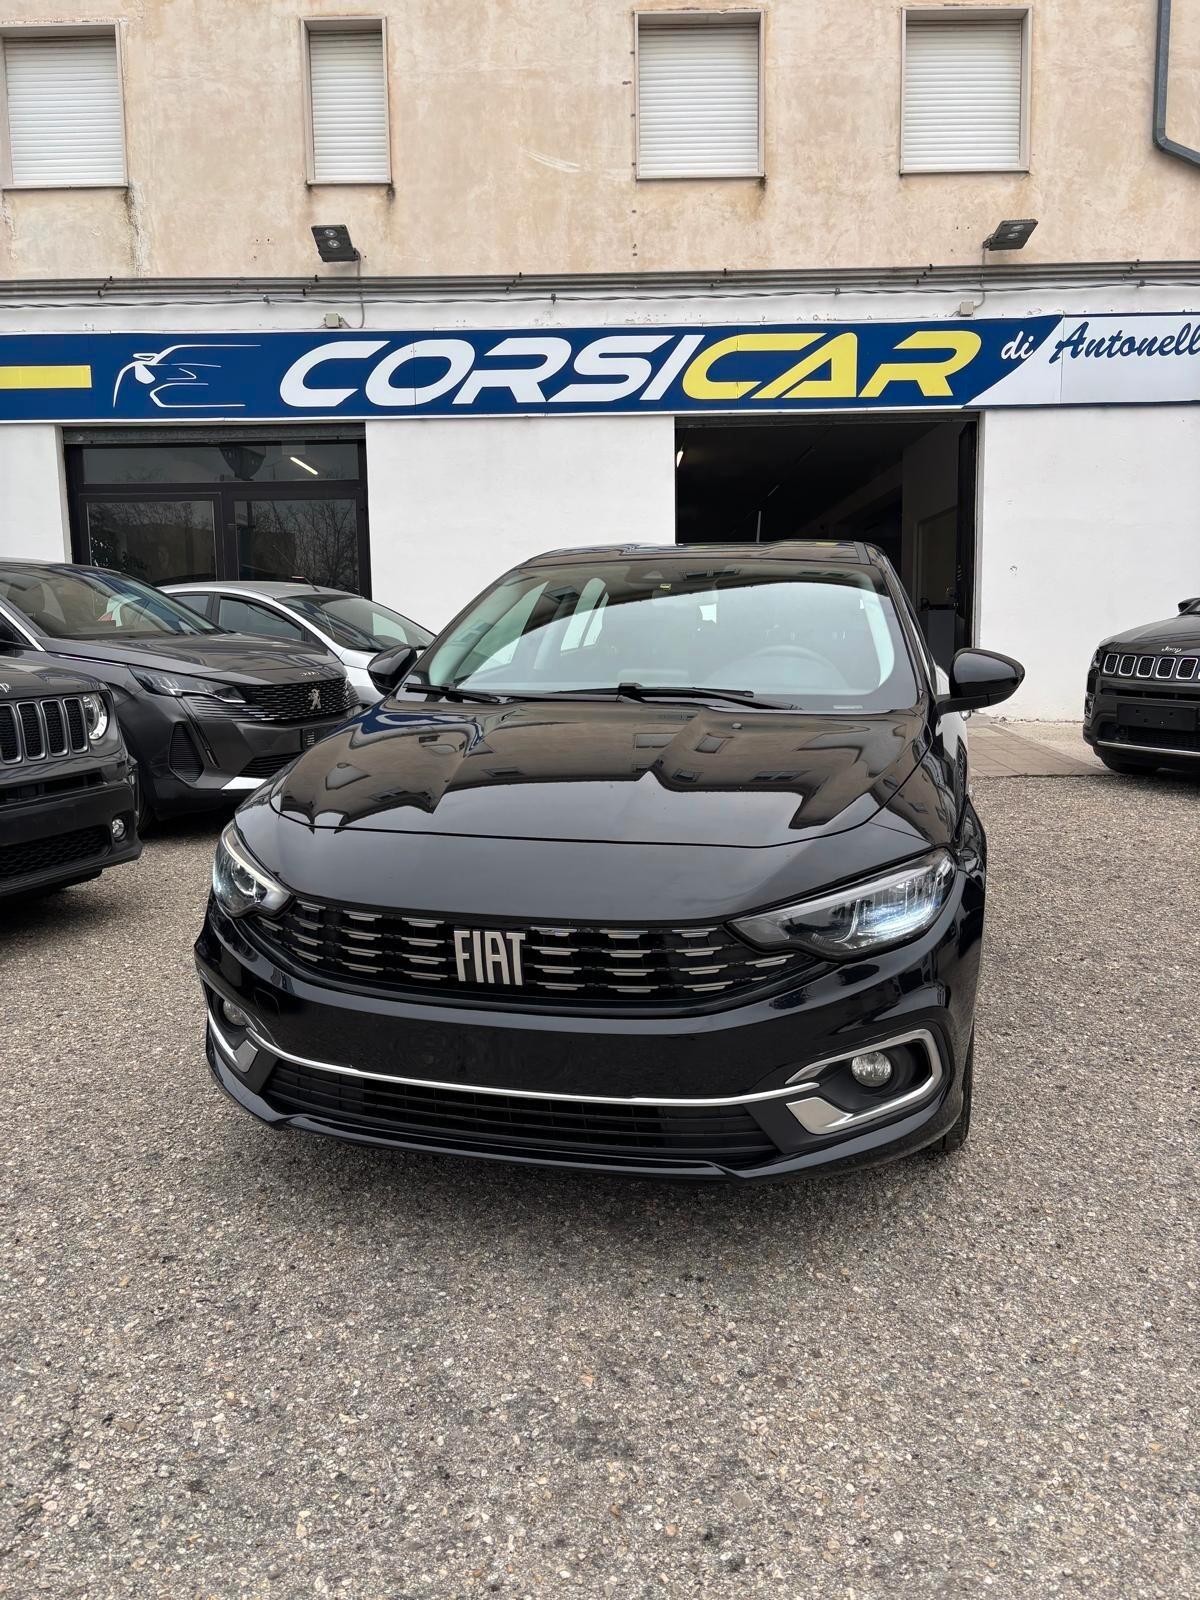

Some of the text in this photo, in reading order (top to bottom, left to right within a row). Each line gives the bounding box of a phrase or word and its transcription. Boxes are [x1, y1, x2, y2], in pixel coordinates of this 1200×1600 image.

[279, 330, 982, 407] CORSICAR
[1001, 330, 1034, 360] di
[453, 930, 526, 986] FIAT
